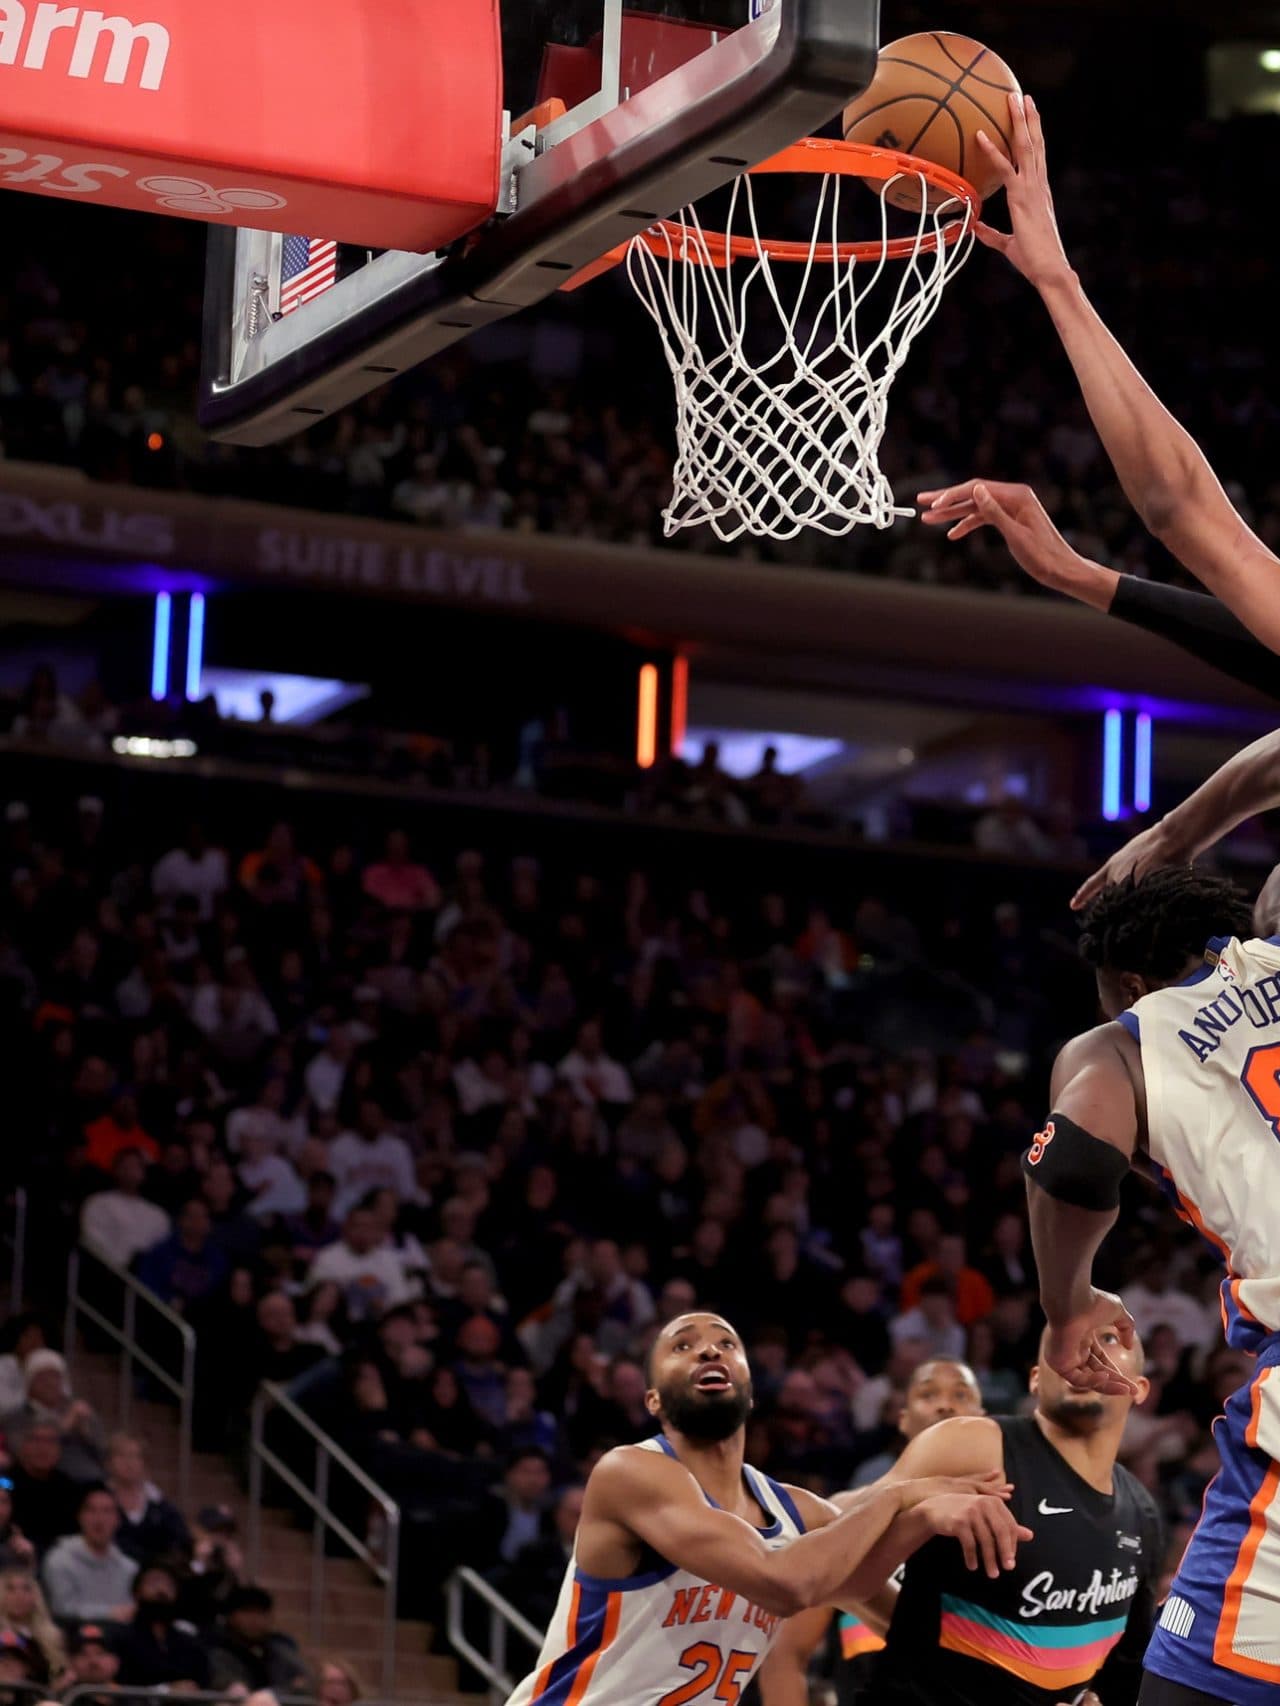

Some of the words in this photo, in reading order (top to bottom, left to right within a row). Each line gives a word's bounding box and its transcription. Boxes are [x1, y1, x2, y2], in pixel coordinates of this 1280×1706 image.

[259, 529, 385, 585] SUITE
[399, 544, 532, 604] LEVEL
[662, 1584, 737, 1628] NEW
[1019, 1571, 1077, 1617] San
[1077, 1566, 1138, 1615] Antoni
[656, 1640, 758, 1706] 25
